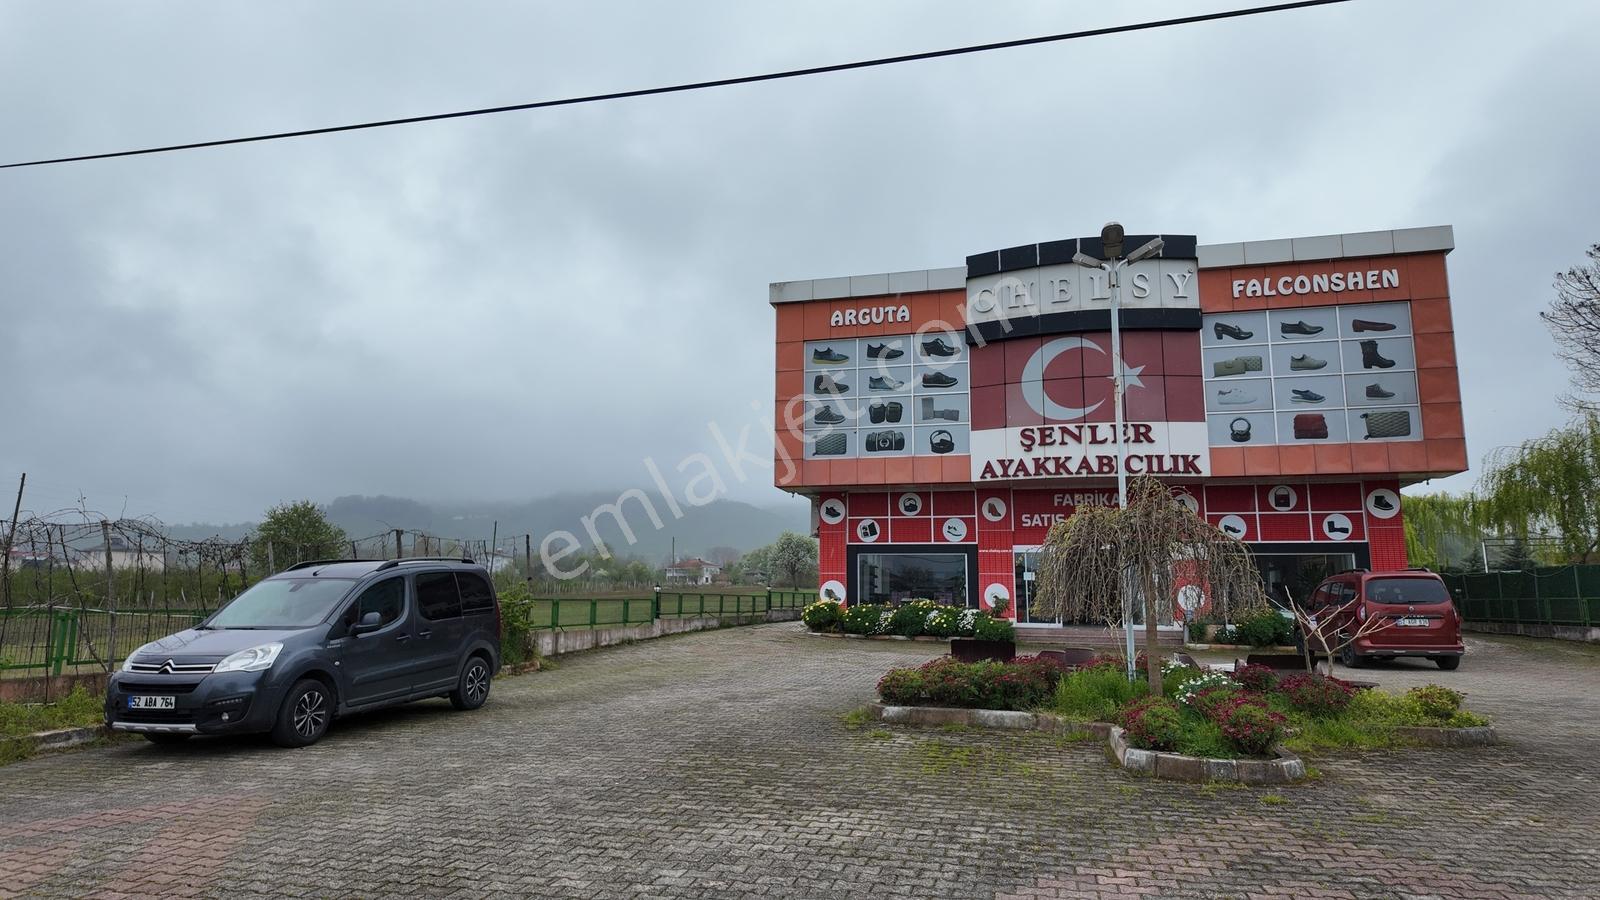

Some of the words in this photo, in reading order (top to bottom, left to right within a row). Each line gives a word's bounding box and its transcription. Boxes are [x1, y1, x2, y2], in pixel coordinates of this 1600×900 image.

[974, 272, 1192, 313] CHELSY
[1232, 269, 1399, 298] FALCONSHEN
[830, 304, 910, 327] ARGUTA
[1020, 423, 1156, 452] ŞENLER
[132, 696, 141, 708] 52
[160, 696, 173, 708] 764
